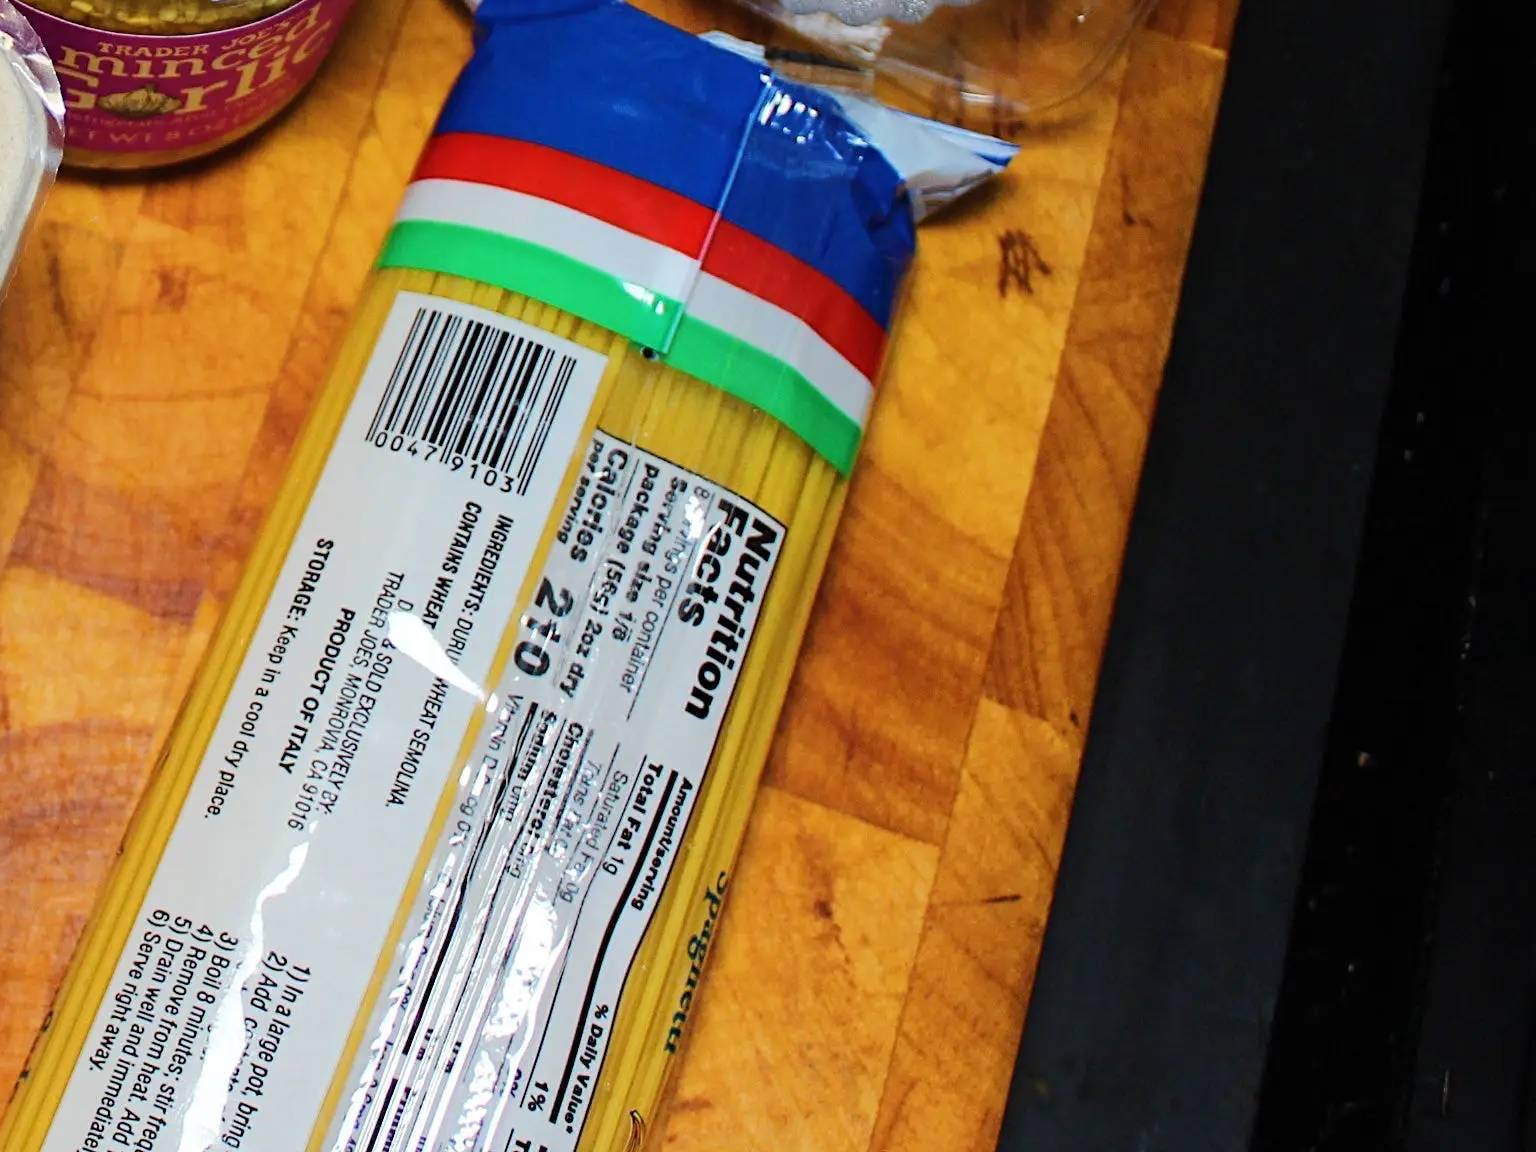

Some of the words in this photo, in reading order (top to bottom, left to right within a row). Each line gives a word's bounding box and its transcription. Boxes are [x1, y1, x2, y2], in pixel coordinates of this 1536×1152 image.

[61, 1, 322, 79] minced
[97, 41, 210, 57] TRADER
[374, 431, 438, 462] 0047
[451, 456, 514, 493] 9103
[583, 439, 606, 472] per
[556, 475, 591, 545] serving
[570, 449, 629, 563] Calories
[616, 463, 660, 555] package
[641, 476, 687, 556] Serving
[442, 501, 481, 574] CONTAINS
[287, 538, 333, 621] STORAGE:
[461, 514, 513, 616] INGREDIENTS:
[626, 562, 650, 603] size
[677, 498, 750, 627] Facts
[368, 571, 404, 629] TRADER
[651, 575, 673, 608] per
[513, 576, 574, 677] 210
[575, 618, 602, 659] 2oz
[684, 518, 787, 720] Nutrition
[267, 624, 297, 664] Keep
[310, 607, 354, 694] PRODUCT
[619, 610, 659, 694] container
[261, 668, 280, 683] in
[365, 652, 392, 693] SOLD
[559, 662, 584, 698] dry
[239, 701, 263, 738] cool
[299, 696, 319, 724] OF
[314, 673, 362, 753] MONROVIA,
[419, 677, 449, 730] WHEAT
[224, 740, 249, 769] dry
[278, 724, 308, 774] ITALY
[328, 694, 375, 791] EXCLUSIVELY
[306, 759, 328, 780] CA
[385, 729, 430, 807] SEMOLINA.
[632, 763, 661, 814] Total
[204, 770, 235, 819] place.
[287, 783, 318, 831] 91016
[585, 770, 628, 851] Saturated
[617, 816, 640, 850] Fat
[630, 776, 693, 911] Amount/serving
[602, 856, 624, 876] 1g
[146, 909, 169, 928] 6)
[168, 916, 191, 935] 5)
[190, 924, 214, 943] 4)
[128, 931, 161, 980] Serve
[151, 938, 183, 984] Drain
[213, 931, 238, 952] 3)
[261, 951, 288, 972] 2)
[164, 945, 205, 1016] Remove
[202, 954, 229, 989] Boil
[250, 973, 278, 1012] Add
[285, 965, 311, 983] 1)
[110, 982, 139, 1023] right
[136, 988, 161, 1023] well
[281, 985, 303, 1003] In
[89, 1023, 119, 1071] away.
[121, 1023, 145, 1058] and
[146, 1018, 177, 1060] from
[163, 1005, 206, 1081] minutes;
[258, 1018, 290, 1063] large
[579, 1023, 604, 1069] Daily
[127, 1061, 159, 1102] heat.
[153, 1083, 175, 1115] stir
[241, 1062, 269, 1097] pot,
[527, 1081, 549, 1112] 1%
[112, 1107, 140, 1146] Add
[221, 1101, 257, 1149] bring
